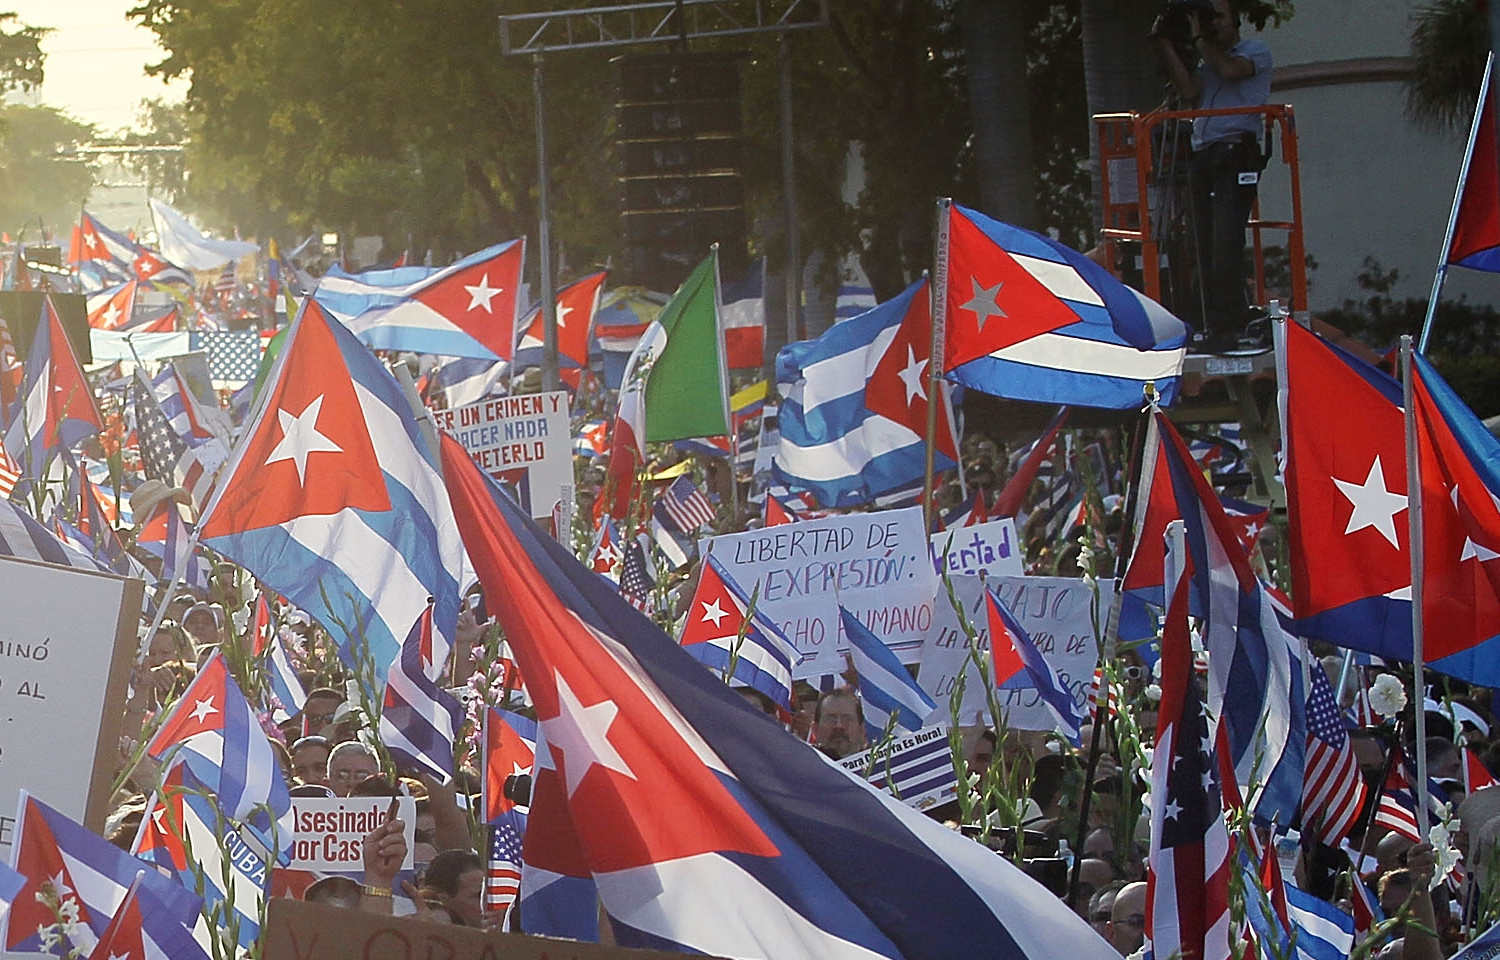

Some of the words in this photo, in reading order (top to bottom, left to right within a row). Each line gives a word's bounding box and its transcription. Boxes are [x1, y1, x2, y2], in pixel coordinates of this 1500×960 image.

[434, 411, 455, 430] ER
[460, 406, 480, 427] UN
[486, 395, 544, 422] CRIMEN
[550, 394, 560, 413] Y
[504, 418, 548, 440] NADA
[472, 441, 545, 469] METERLO
[734, 526, 854, 565] LIBERTAD
[866, 522, 900, 549] DE
[764, 549, 917, 601] EXPRESIÓN:
[936, 626, 957, 648] LA
[1065, 635, 1091, 656] DE
[17, 680, 47, 700] AL
[903, 738, 915, 750] Es
[915, 727, 942, 744] Hora!
[222, 830, 267, 885] CUBA
[323, 834, 365, 862] Cas
